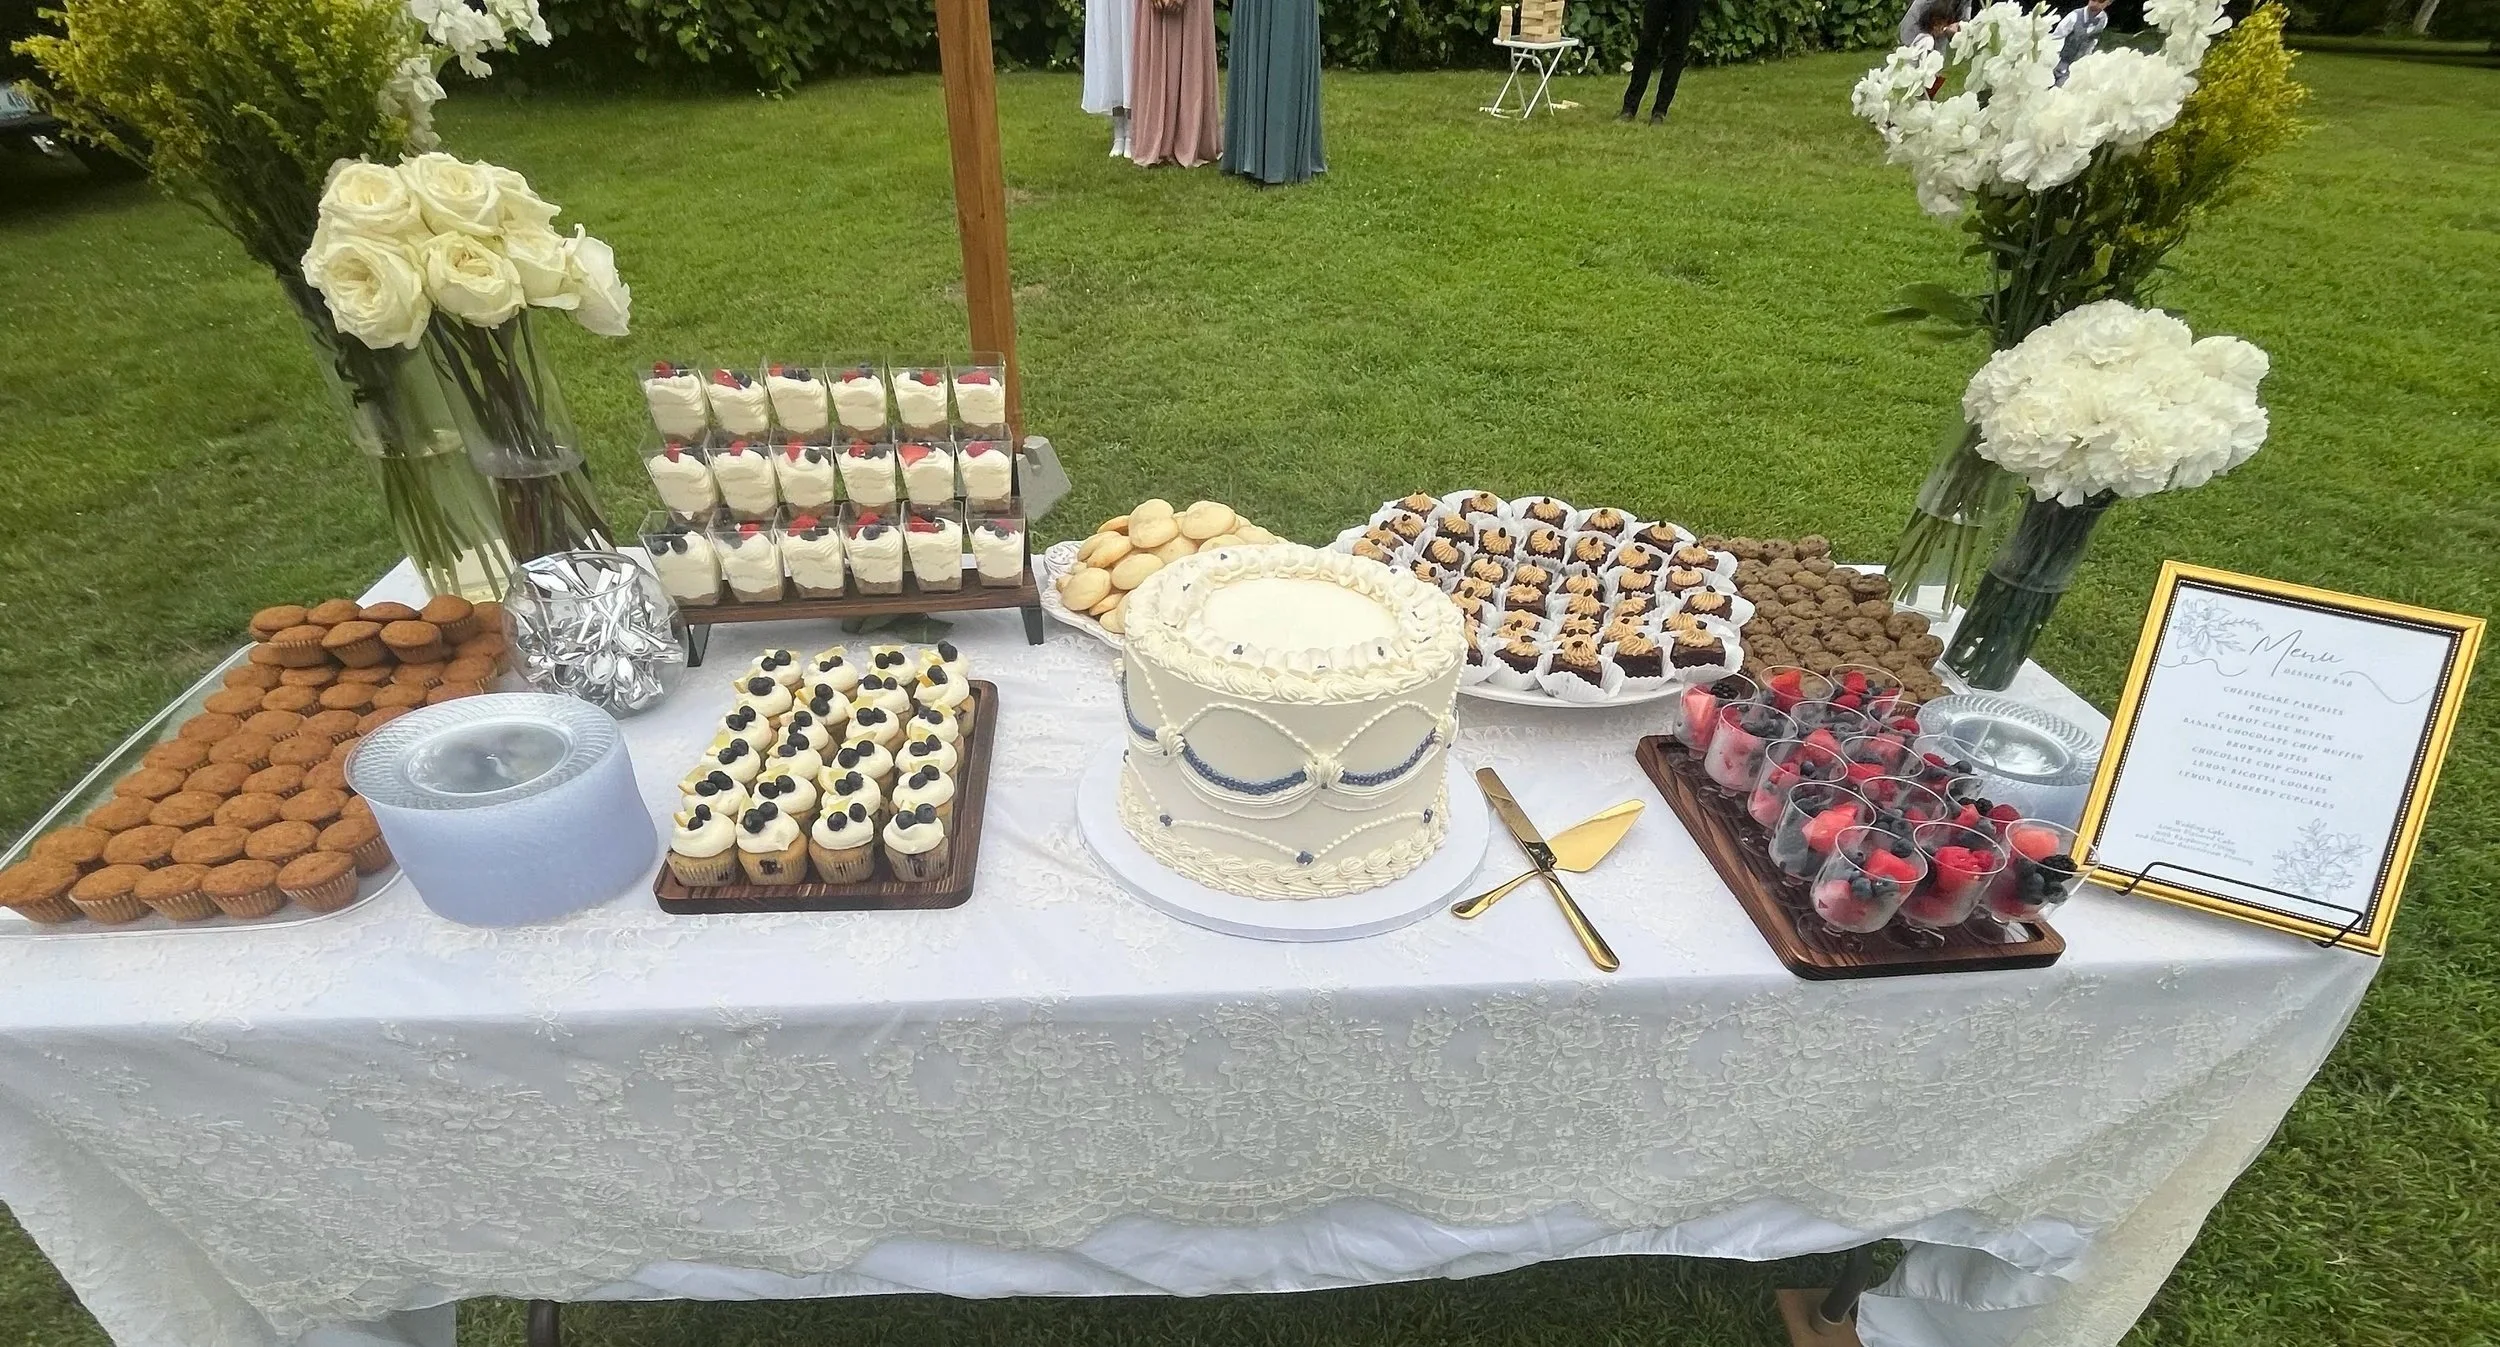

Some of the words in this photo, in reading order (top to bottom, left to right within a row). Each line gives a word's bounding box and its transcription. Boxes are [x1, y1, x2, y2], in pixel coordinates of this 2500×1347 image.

[2249, 629, 2344, 677] Menu
[2284, 667, 2329, 682] DESSERT
[2332, 677, 2353, 687] BAR
[2223, 686, 2289, 704] CHEESECAKE
[2293, 700, 2344, 716] PARFAITS
[2248, 704, 2280, 716] FRUIT
[2283, 712, 2310, 722] CUPS
[2183, 716, 2223, 731] BANANA
[2226, 727, 2288, 745] CHOCOLATE
[2292, 741, 2319, 751] CHIP
[2322, 747, 2364, 760] MUFFIN
[2217, 711, 2260, 725] CARROT
[2262, 721, 2290, 732] CAKE
[2294, 728, 2335, 741] MUFFIN
[2191, 746, 2253, 765] CHOCOLATE
[2255, 760, 2282, 771] CHIP
[2285, 766, 2332, 782] COOKIES
[2225, 740, 2274, 756] BROWNIE
[2276, 751, 2309, 763] BITES
[2178, 770, 2213, 783] LEMON
[2215, 778, 2276, 796] BLUEBERRY
[2279, 793, 2336, 810] CUPCAKES
[2192, 759, 2227, 772] LEMON
[2230, 768, 2276, 784] RICOTTA
[2280, 779, 2328, 794] COOKIES
